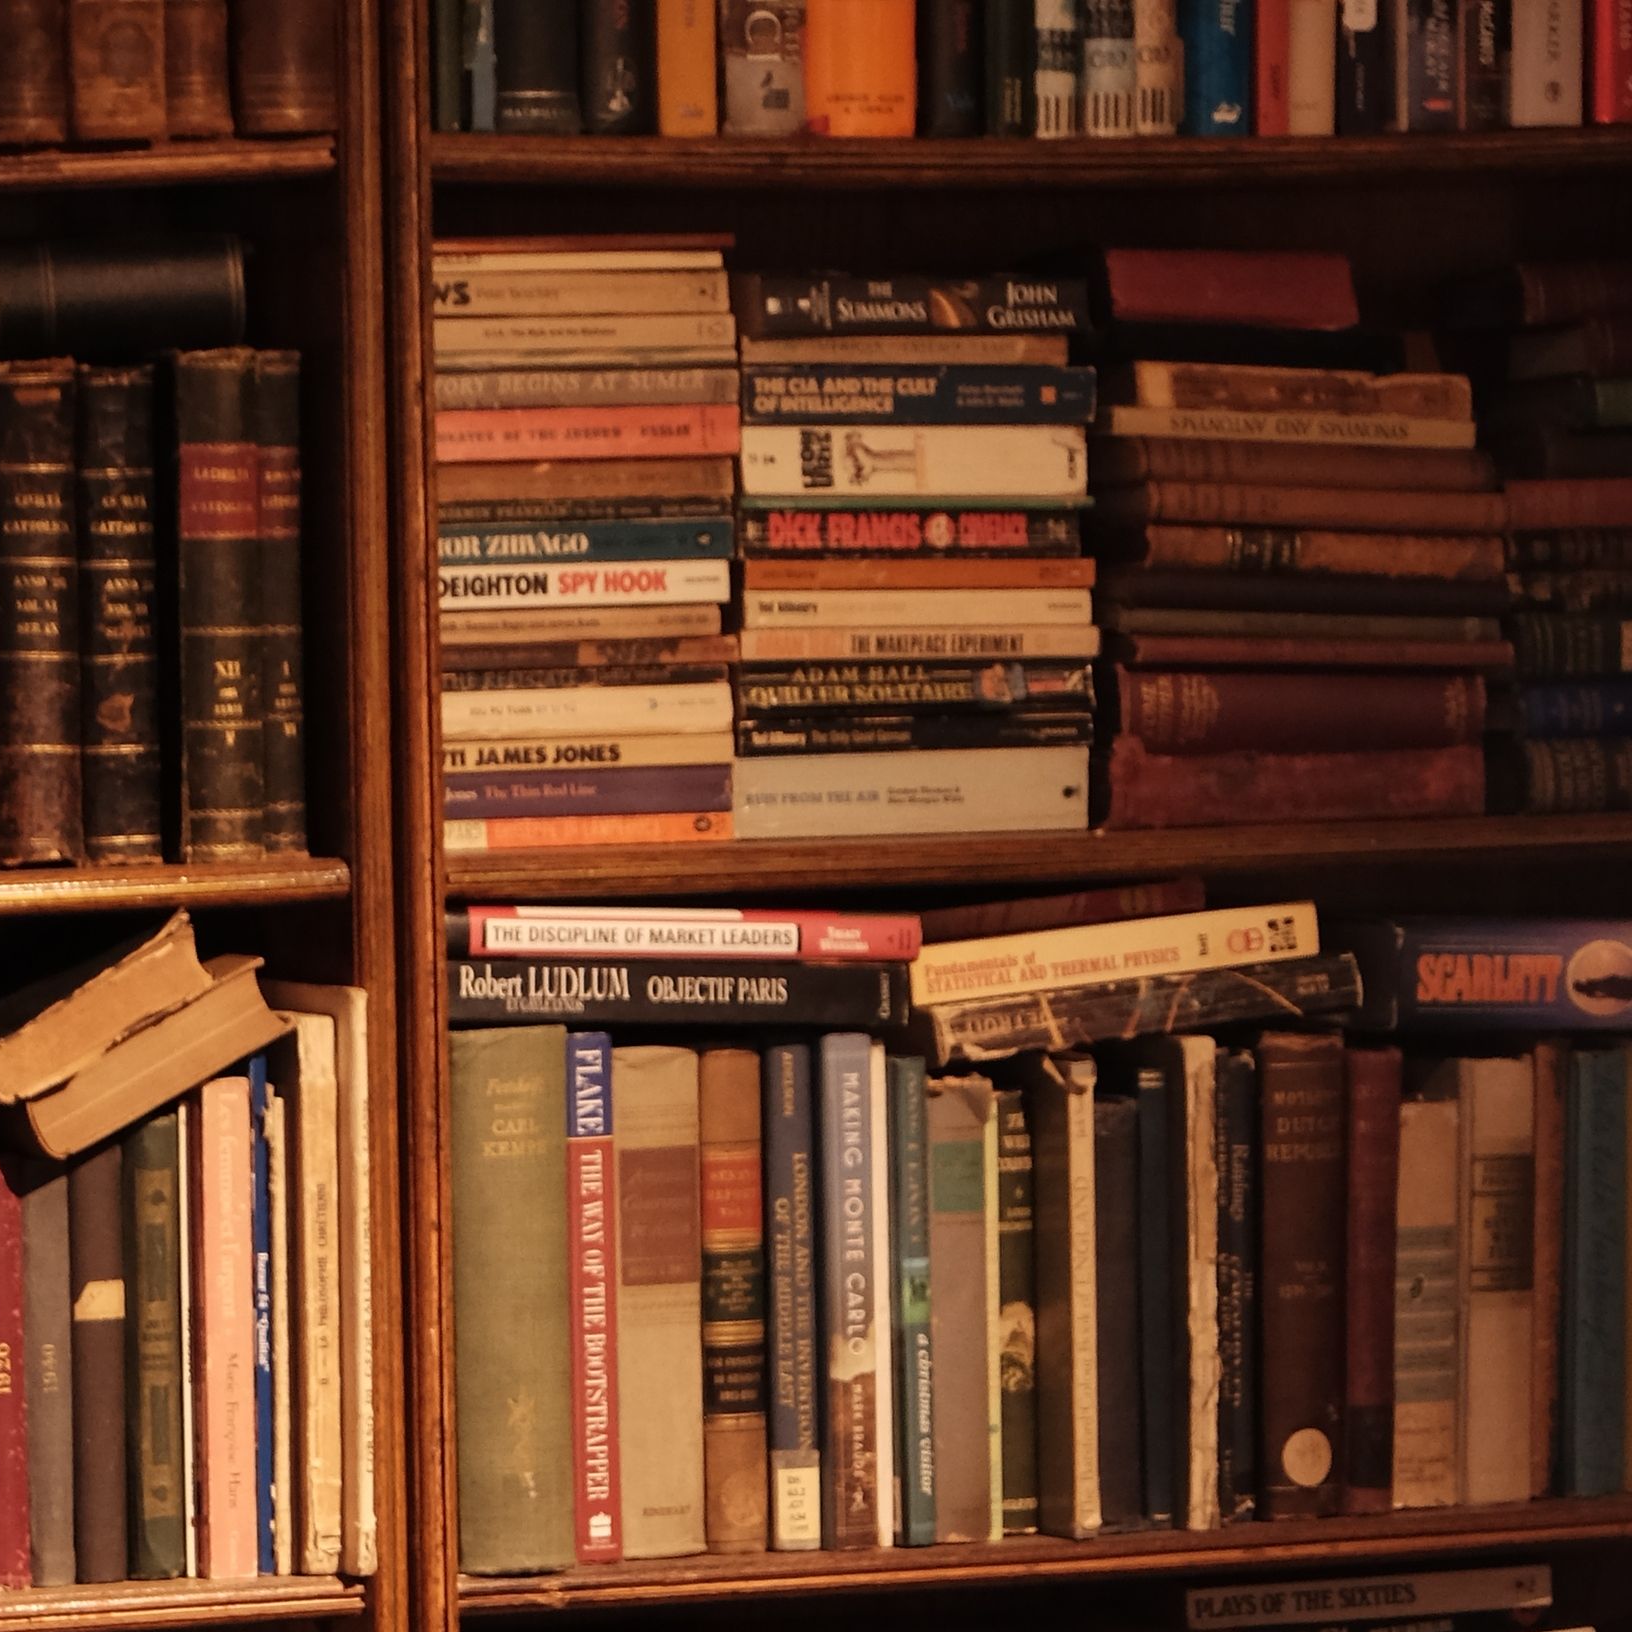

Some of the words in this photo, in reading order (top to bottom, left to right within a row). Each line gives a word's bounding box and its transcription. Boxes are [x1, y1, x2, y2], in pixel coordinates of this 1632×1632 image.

[868, 281, 893, 298] THE
[1006, 281, 1059, 306] JOHN
[836, 299, 928, 323] SUMMONS
[986, 305, 1077, 330] GRISHAM
[754, 377, 787, 395] THE
[789, 377, 820, 394] CIA
[823, 377, 860, 394] AND
[864, 377, 895, 395] THE
[897, 377, 939, 396] CULT
[754, 396, 778, 414] OF
[780, 396, 894, 414] INTELLIGENCE
[485, 531, 590, 557] ZHIVAGO
[768, 512, 822, 549] DICK
[827, 512, 922, 549] FRANCIS
[558, 571, 599, 595] SPY
[603, 569, 668, 593] HOOK
[792, 666, 859, 683] ADAM
[870, 665, 927, 683] HALL
[475, 746, 546, 766] JAMES
[553, 743, 621, 764] JONES
[493, 925, 523, 942] THE
[528, 926, 618, 943] DISCIPLINE
[624, 927, 644, 944] OF
[648, 928, 716, 945] MARKET
[721, 929, 793, 946] LEADERS
[924, 952, 1019, 977] Fundamentals
[1021, 950, 1037, 966] of
[926, 969, 1013, 994] STATISTICAL
[1019, 965, 1048, 984] AND
[1052, 955, 1117, 977] THERMAL
[1123, 946, 1181, 968] PHYSICS
[1415, 952, 1564, 1005] SCARLETT
[459, 963, 523, 1000] Robert
[527, 966, 632, 1001] LUDLUM
[646, 975, 735, 1005] OBJECTIF
[737, 976, 789, 1006] PARIS
[575, 1048, 605, 1137] FLAKE
[841, 1072, 864, 1168] MAKING
[580, 1149, 603, 1196] THE
[774, 1196, 792, 1224] OF
[791, 1151, 809, 1238] LONDON
[581, 1200, 605, 1246] WAY
[843, 1178, 865, 1261] MONTE
[582, 1249, 606, 1279] OF
[775, 1231, 792, 1270] THE
[795, 1246, 811, 1287] AND
[582, 1281, 607, 1329] THE
[776, 1275, 794, 1354] MIDDLE
[796, 1295, 811, 1330] THE
[845, 1271, 867, 1356] CARLO
[41, 1343, 59, 1394] 1940
[777, 1358, 795, 1407] EAST
[797, 1338, 815, 1449] INVENTION
[917, 1349, 933, 1434] christmas
[584, 1333, 610, 1502] BOOTSTRAPPER
[919, 1436, 935, 1497] visitor
[1195, 1594, 1256, 1619] PLAYS
[1262, 1593, 1283, 1614] OF
[1295, 1589, 1334, 1613] THE
[1338, 1583, 1417, 1608] SIXTIES
